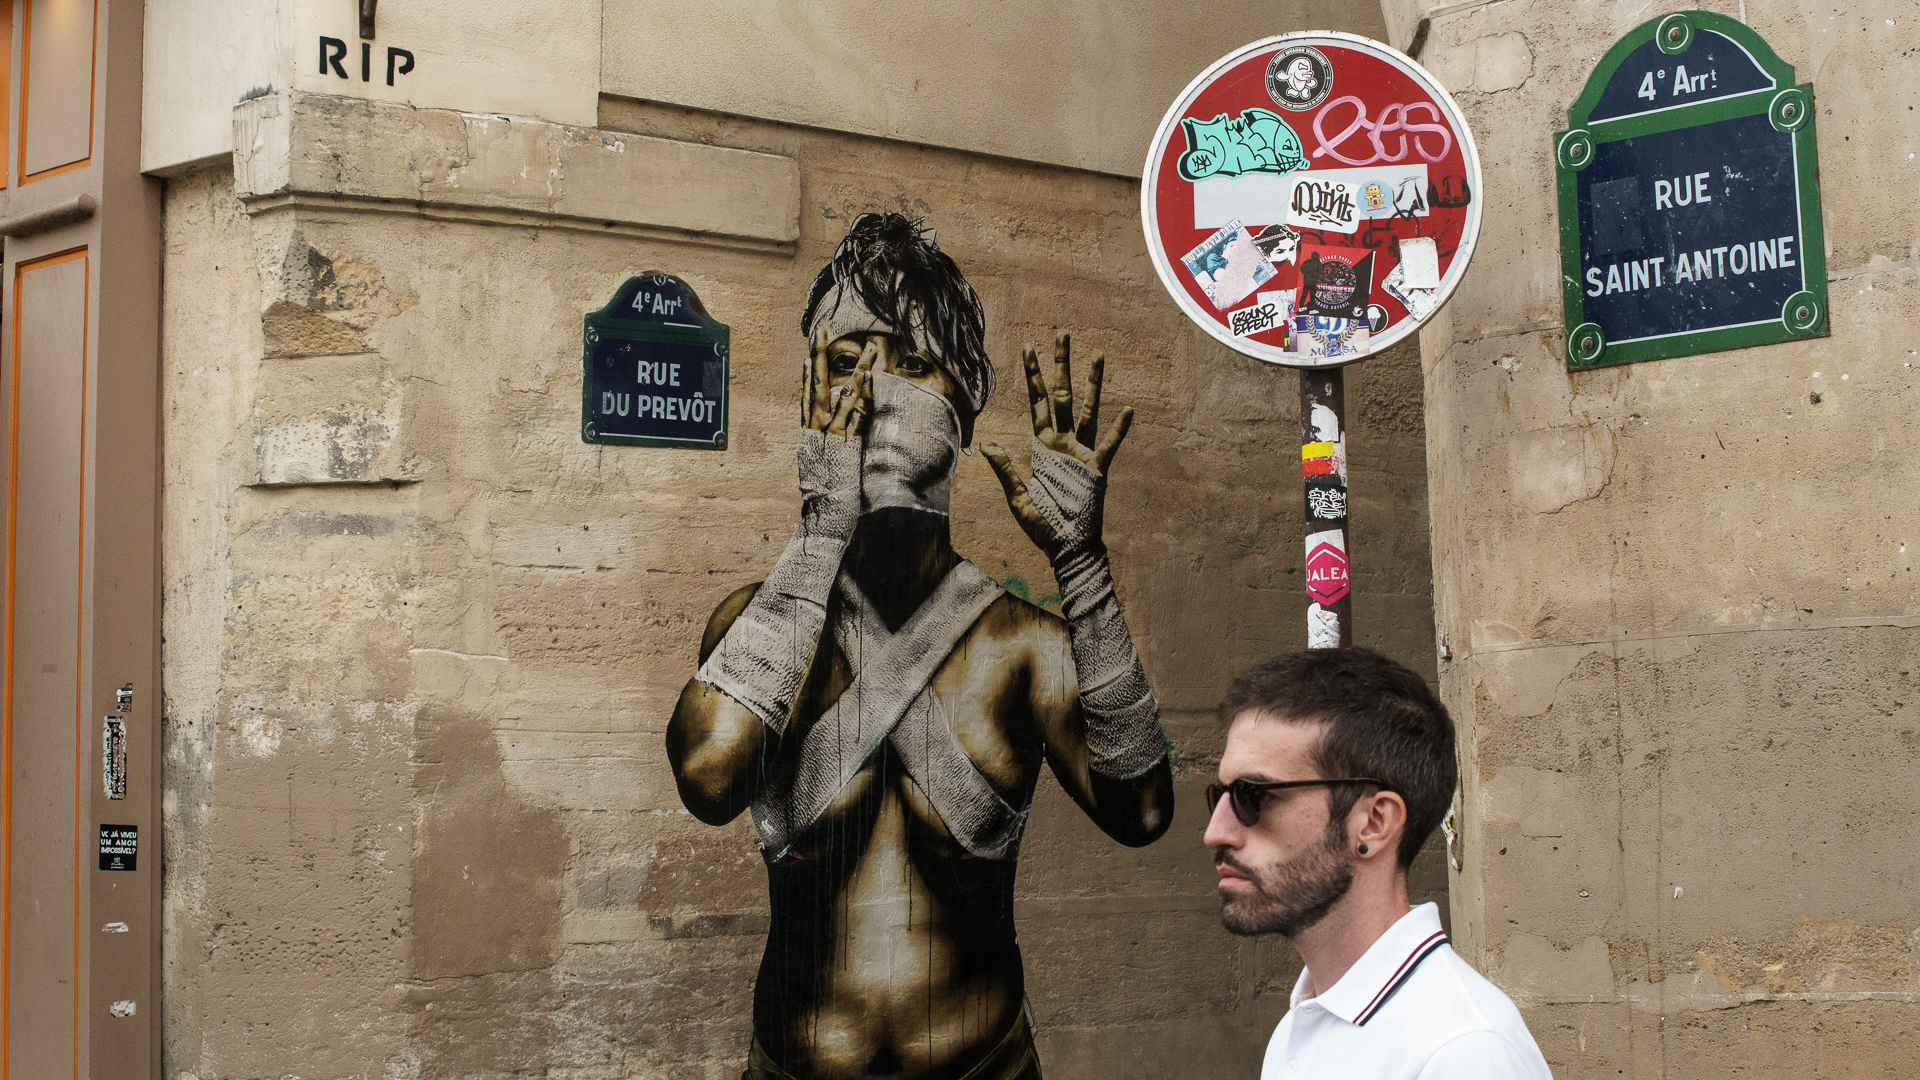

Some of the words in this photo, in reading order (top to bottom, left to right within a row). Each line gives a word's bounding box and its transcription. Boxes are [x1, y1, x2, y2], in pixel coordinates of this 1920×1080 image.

[319, 35, 415, 86] RIP
[1655, 172, 1712, 211] RUE
[1586, 257, 1665, 297] SAINT
[1675, 236, 1796, 284] ANTOINE
[1232, 303, 1276, 325] GROUND
[1233, 312, 1279, 337] EFFECT
[637, 360, 681, 387] RUE
[601, 391, 630, 417] DU
[637, 391, 716, 423] PREVÔT
[1307, 567, 1349, 582] JALEA
